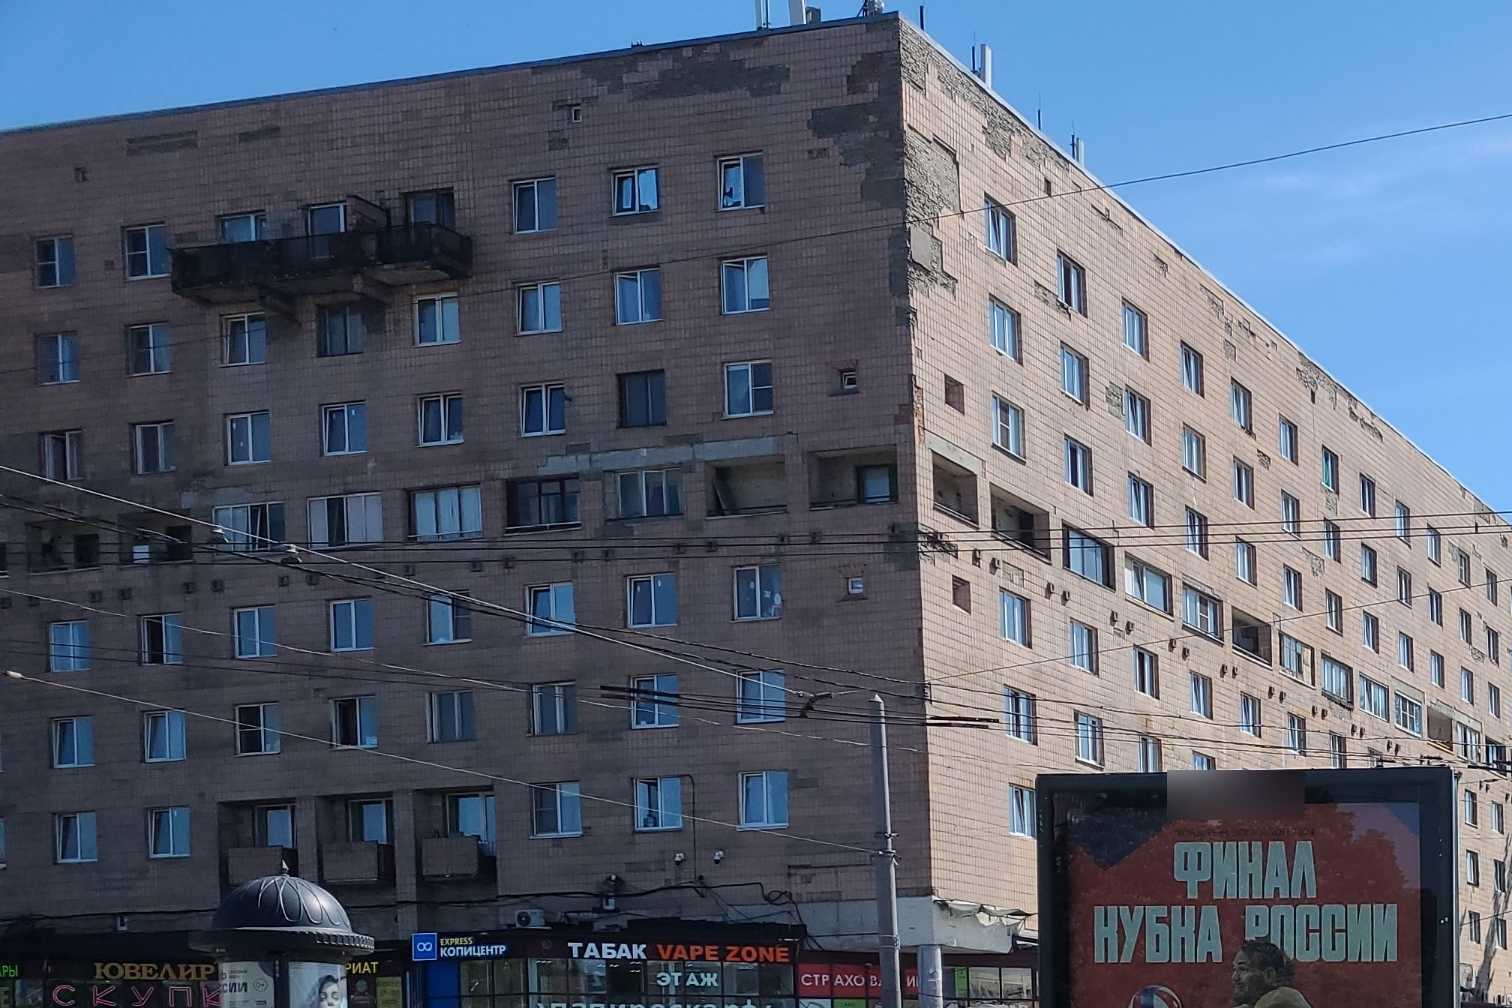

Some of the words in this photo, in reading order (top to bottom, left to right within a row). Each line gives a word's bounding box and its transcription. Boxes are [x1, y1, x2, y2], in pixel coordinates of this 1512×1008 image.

[1173, 840, 1318, 900] ФИНАЛ
[440, 937, 474, 946] EXPRESS
[1093, 905, 1224, 964] КУБКА
[1244, 903, 1399, 963] РОССИИ
[440, 944, 507, 958] КОПИЦЕНТР
[567, 942, 647, 960] ТАБАК
[657, 944, 719, 961] VAPE
[725, 946, 790, 963] ZONE
